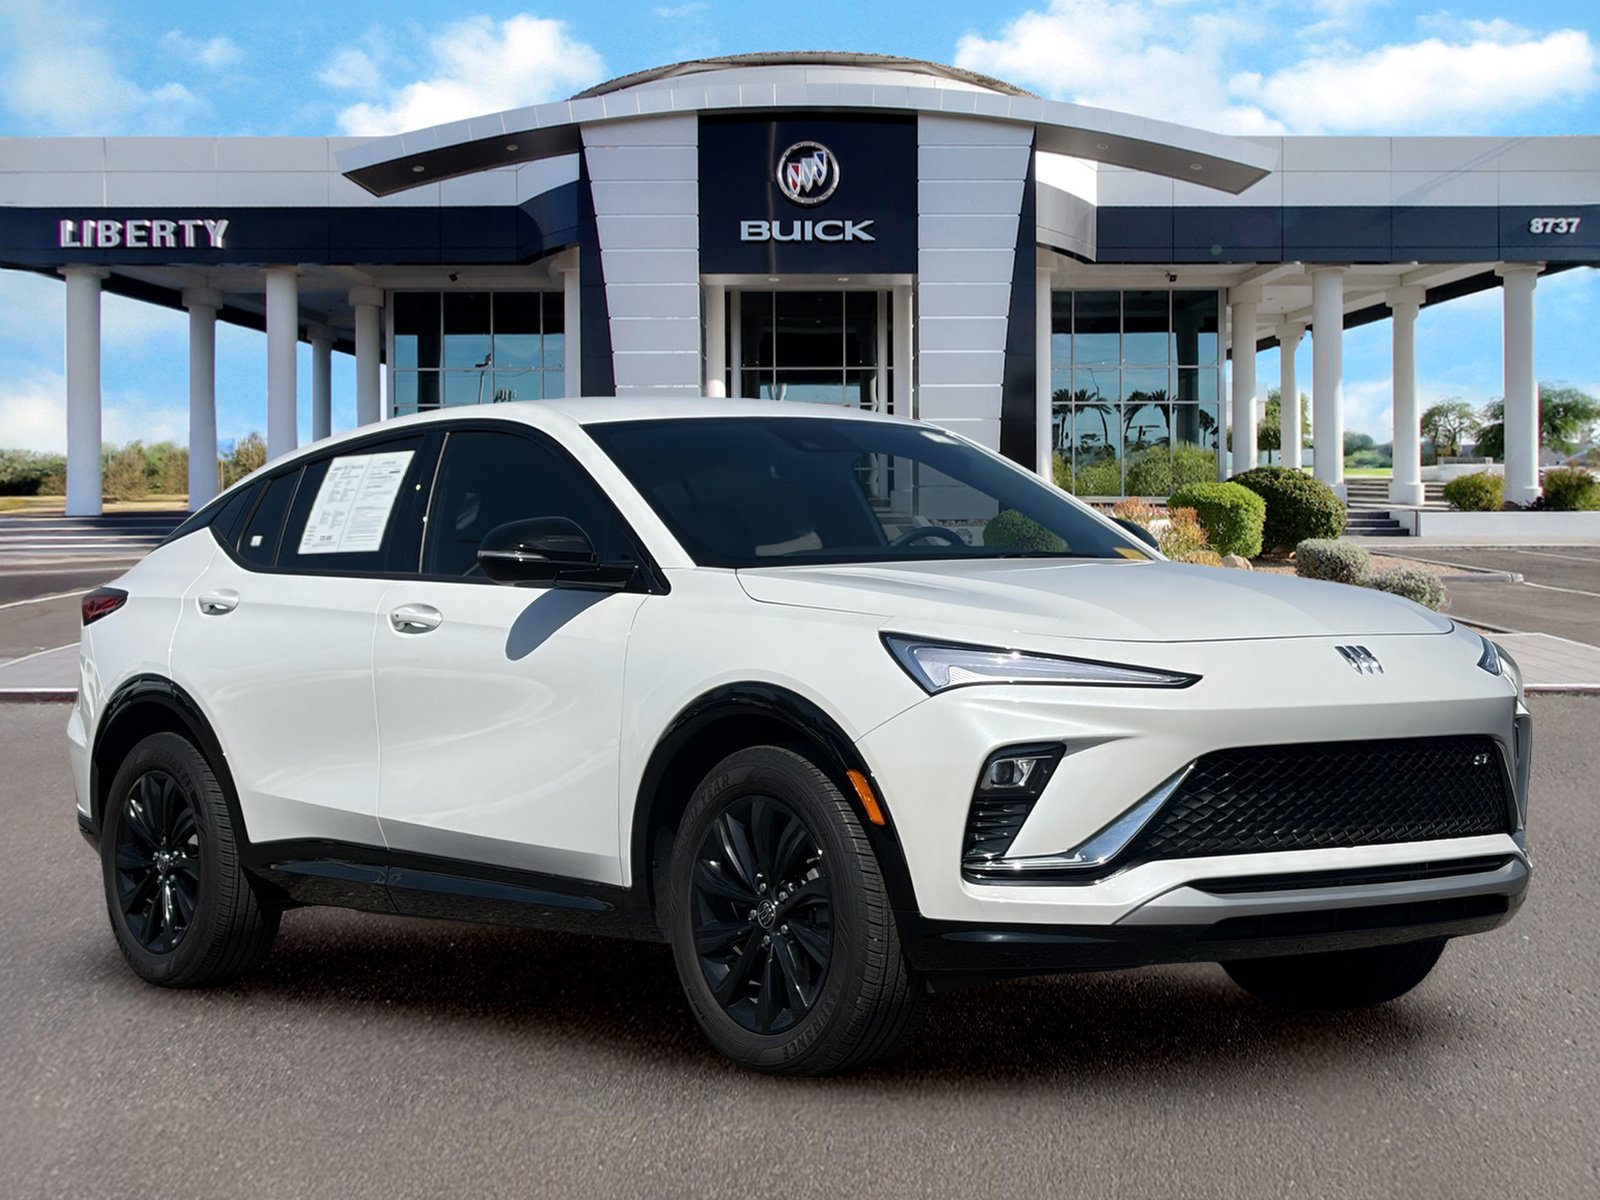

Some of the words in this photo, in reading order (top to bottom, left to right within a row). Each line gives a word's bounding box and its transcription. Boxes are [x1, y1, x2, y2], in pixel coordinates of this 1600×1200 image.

[59, 219, 229, 248] LIBERTY
[740, 220, 876, 241] BUICK
[1529, 217, 1581, 234] 8737
